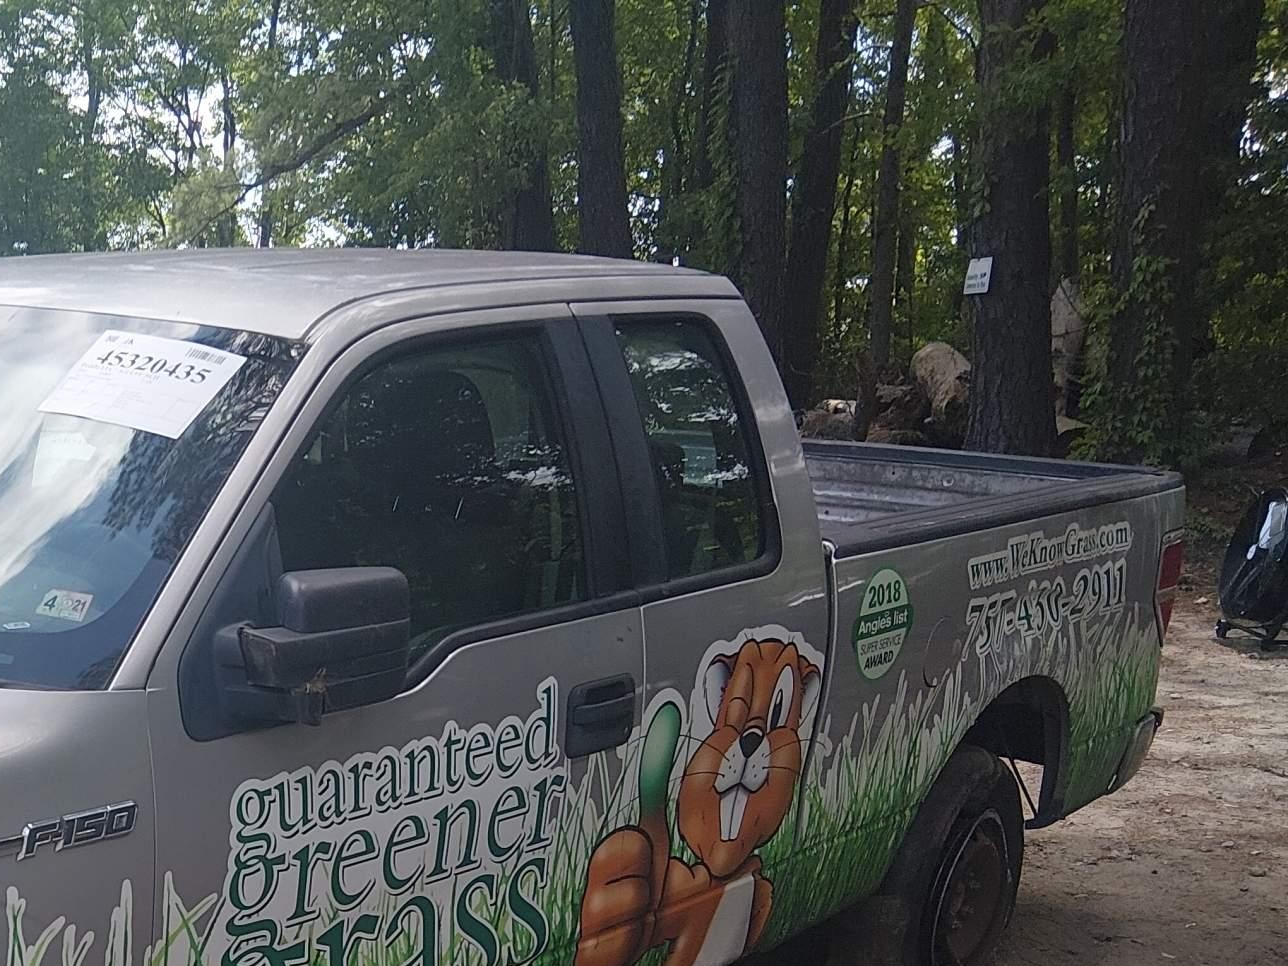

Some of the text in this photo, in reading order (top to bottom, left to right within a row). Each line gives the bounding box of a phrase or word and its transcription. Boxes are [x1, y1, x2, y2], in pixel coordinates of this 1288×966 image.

[97, 349, 212, 385] 45320435
[970, 526, 1130, 583] www.WeKnowGrass.com
[43, 594, 58, 612] 4
[868, 580, 901, 609] 2018
[893, 608, 908, 626] list
[864, 650, 894, 671] AWARD
[233, 680, 560, 852] guaranteed
[226, 773, 566, 938] greener
